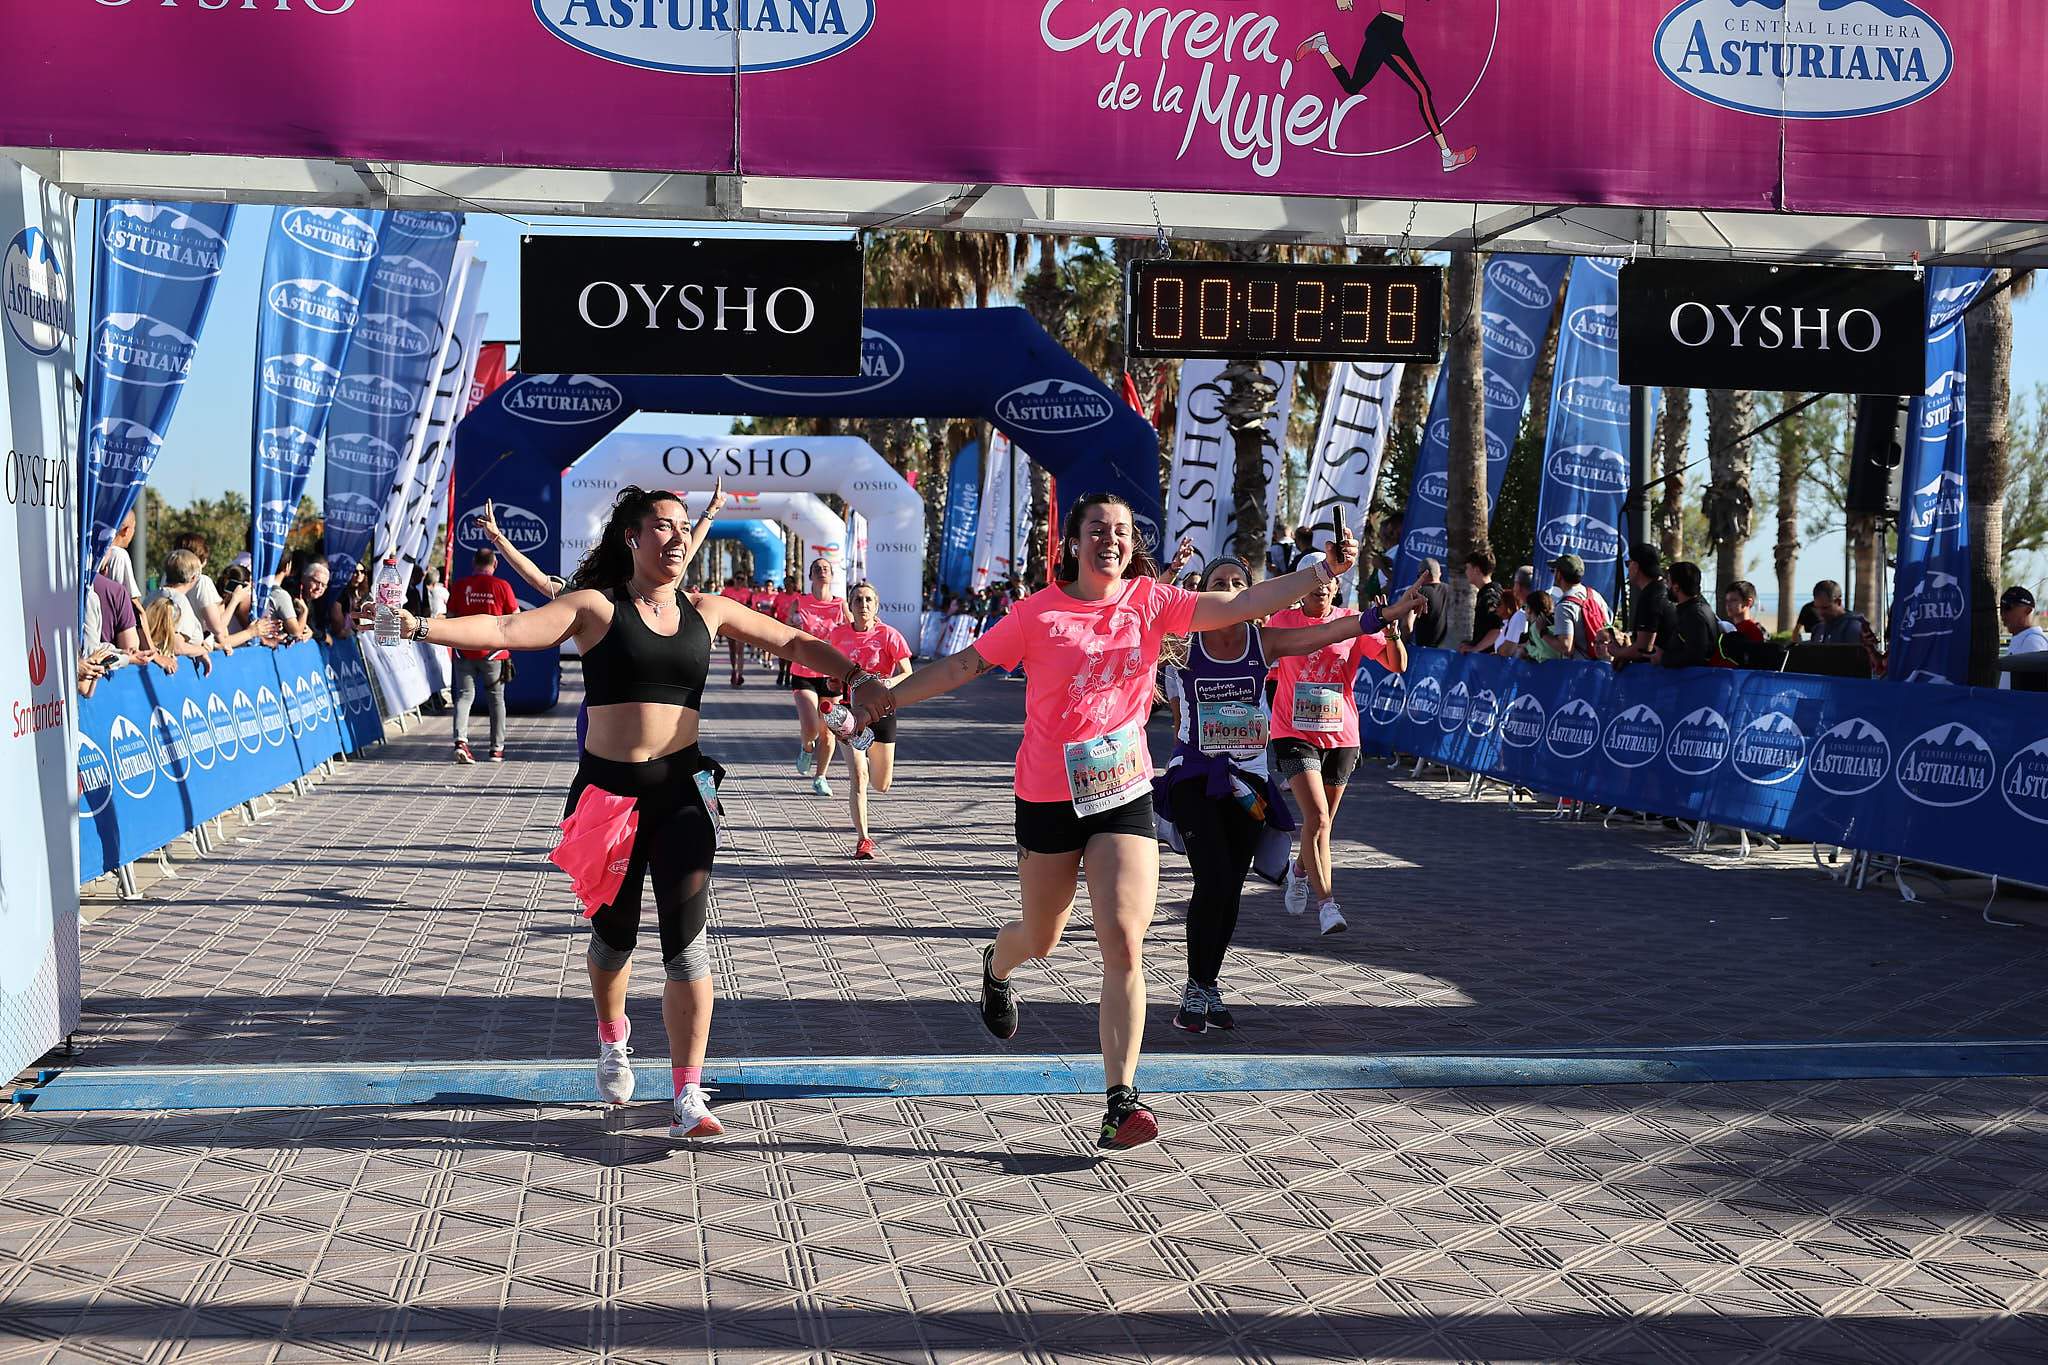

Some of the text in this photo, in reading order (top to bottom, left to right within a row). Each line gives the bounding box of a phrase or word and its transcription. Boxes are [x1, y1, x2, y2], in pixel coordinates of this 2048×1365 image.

[1040, 0, 1280, 63] Carrera
[1723, 18, 1921, 39] CENTRAL LECHERA
[1676, 19, 1930, 82] ASTURIANA
[1097, 58, 1369, 178] de la Mujer
[6, 261, 65, 331] ASTURIANA
[375, 270, 436, 292] STURIANA
[578, 281, 815, 334] OYSHO
[1152, 277, 1418, 345] 00:42:38
[1669, 301, 1882, 353] OYSHO
[509, 389, 613, 412] ASTURIANA
[1005, 400, 1107, 421] ASTURIANA
[662, 446, 812, 478] OYSHO
[5, 450, 69, 510] OYSHO
[572, 479, 618, 489] OYSHO
[853, 480, 898, 491] OYSHO
[875, 543, 919, 553] OYSHO
[1544, 528, 1619, 556] ASTURIANA
[13, 693, 65, 738] Santander
[1550, 719, 1594, 746] ASTURIANA
[1605, 724, 1659, 754] ASTURIANA
[1669, 730, 1723, 760] ASTURIANA
[1736, 735, 1798, 769] ASTURIANA
[1813, 743, 1882, 778] ASTURIANA
[1900, 750, 1985, 790] ASTURIANA
